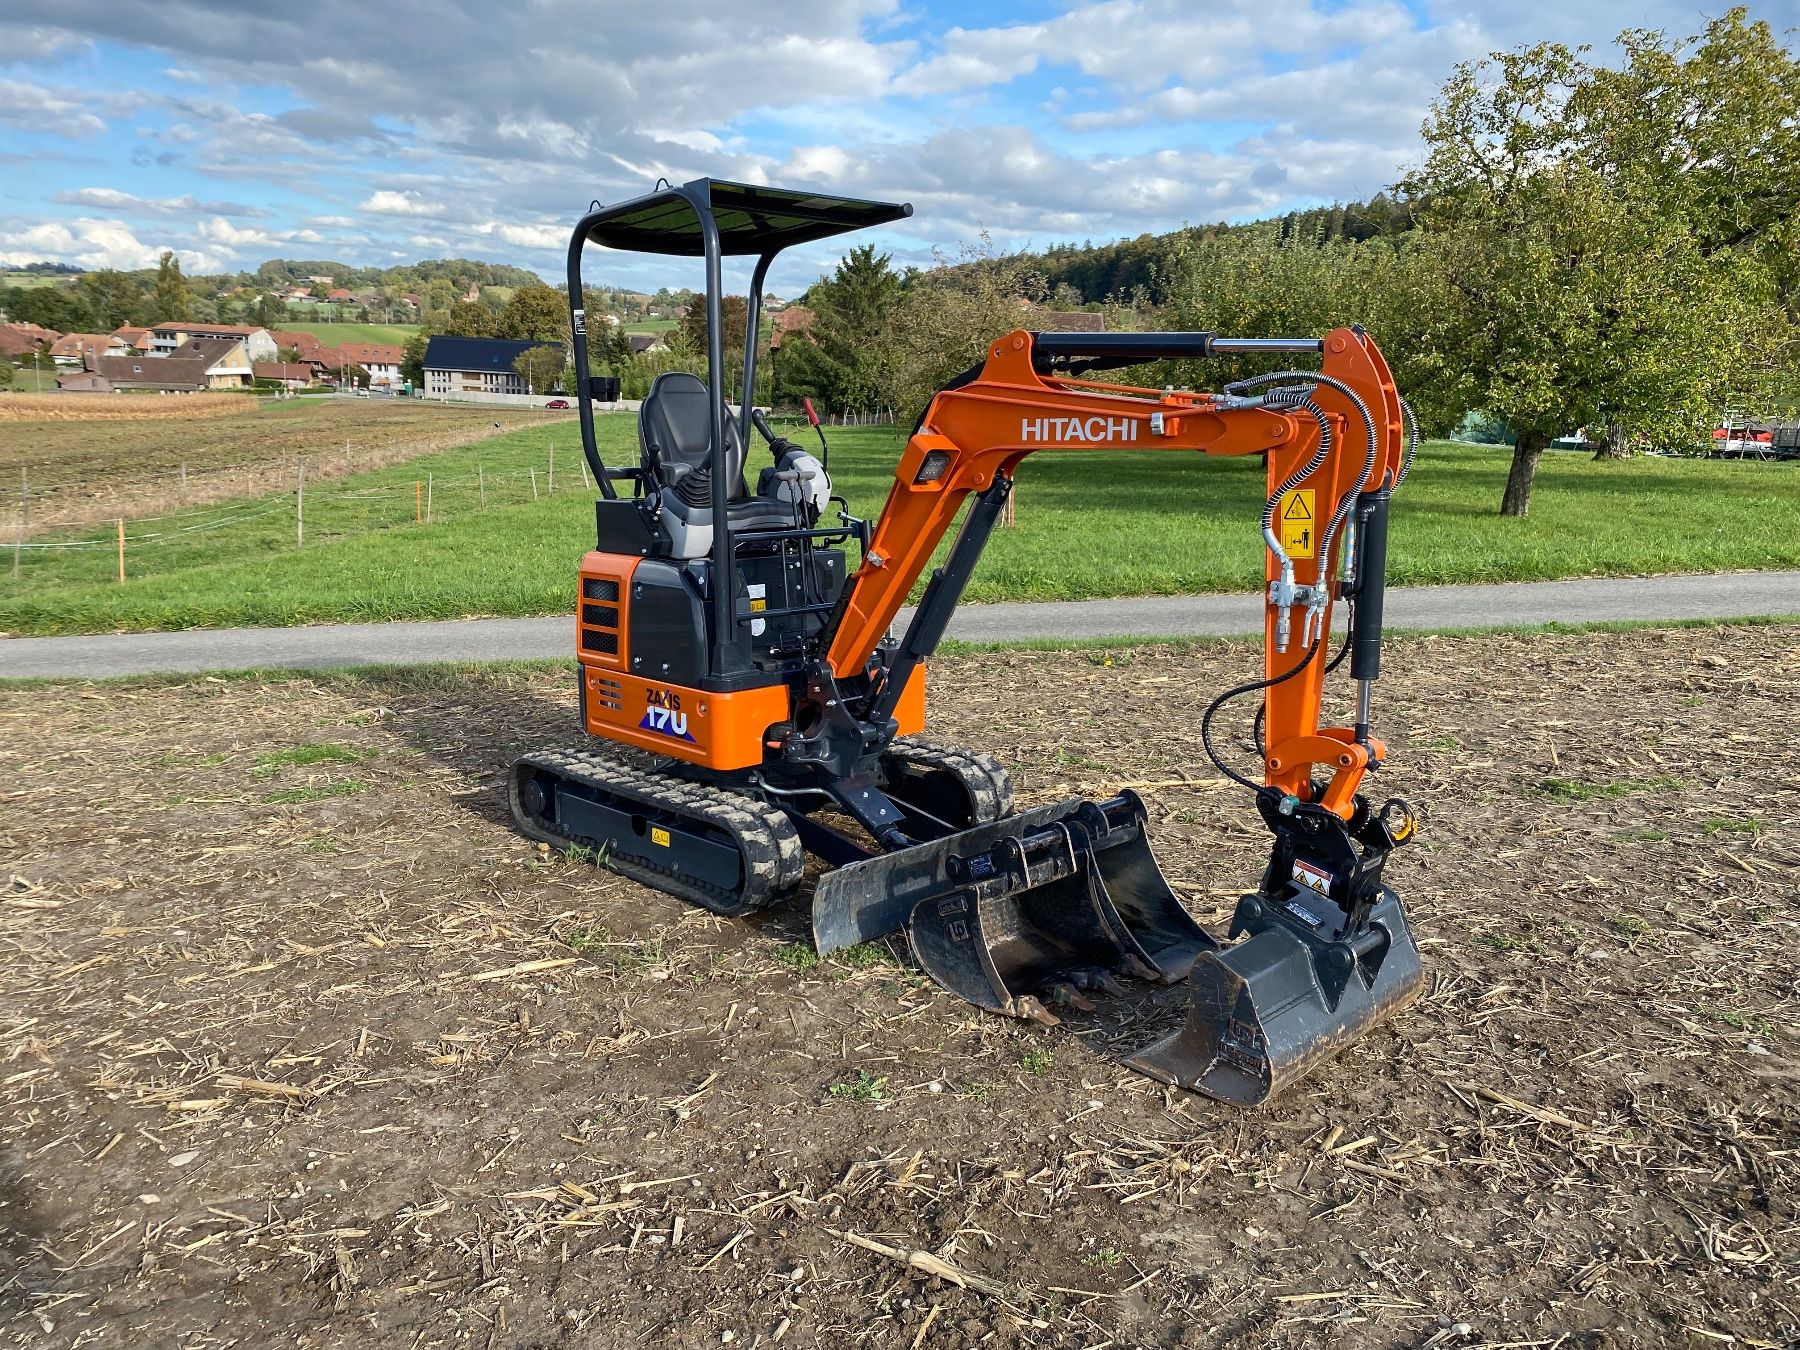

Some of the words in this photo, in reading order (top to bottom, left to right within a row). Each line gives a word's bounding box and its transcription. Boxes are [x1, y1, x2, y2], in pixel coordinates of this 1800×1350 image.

[1021, 417, 1138, 442] HITACHI
[646, 688, 681, 711] ZAXIS
[646, 705, 687, 735] 17U
